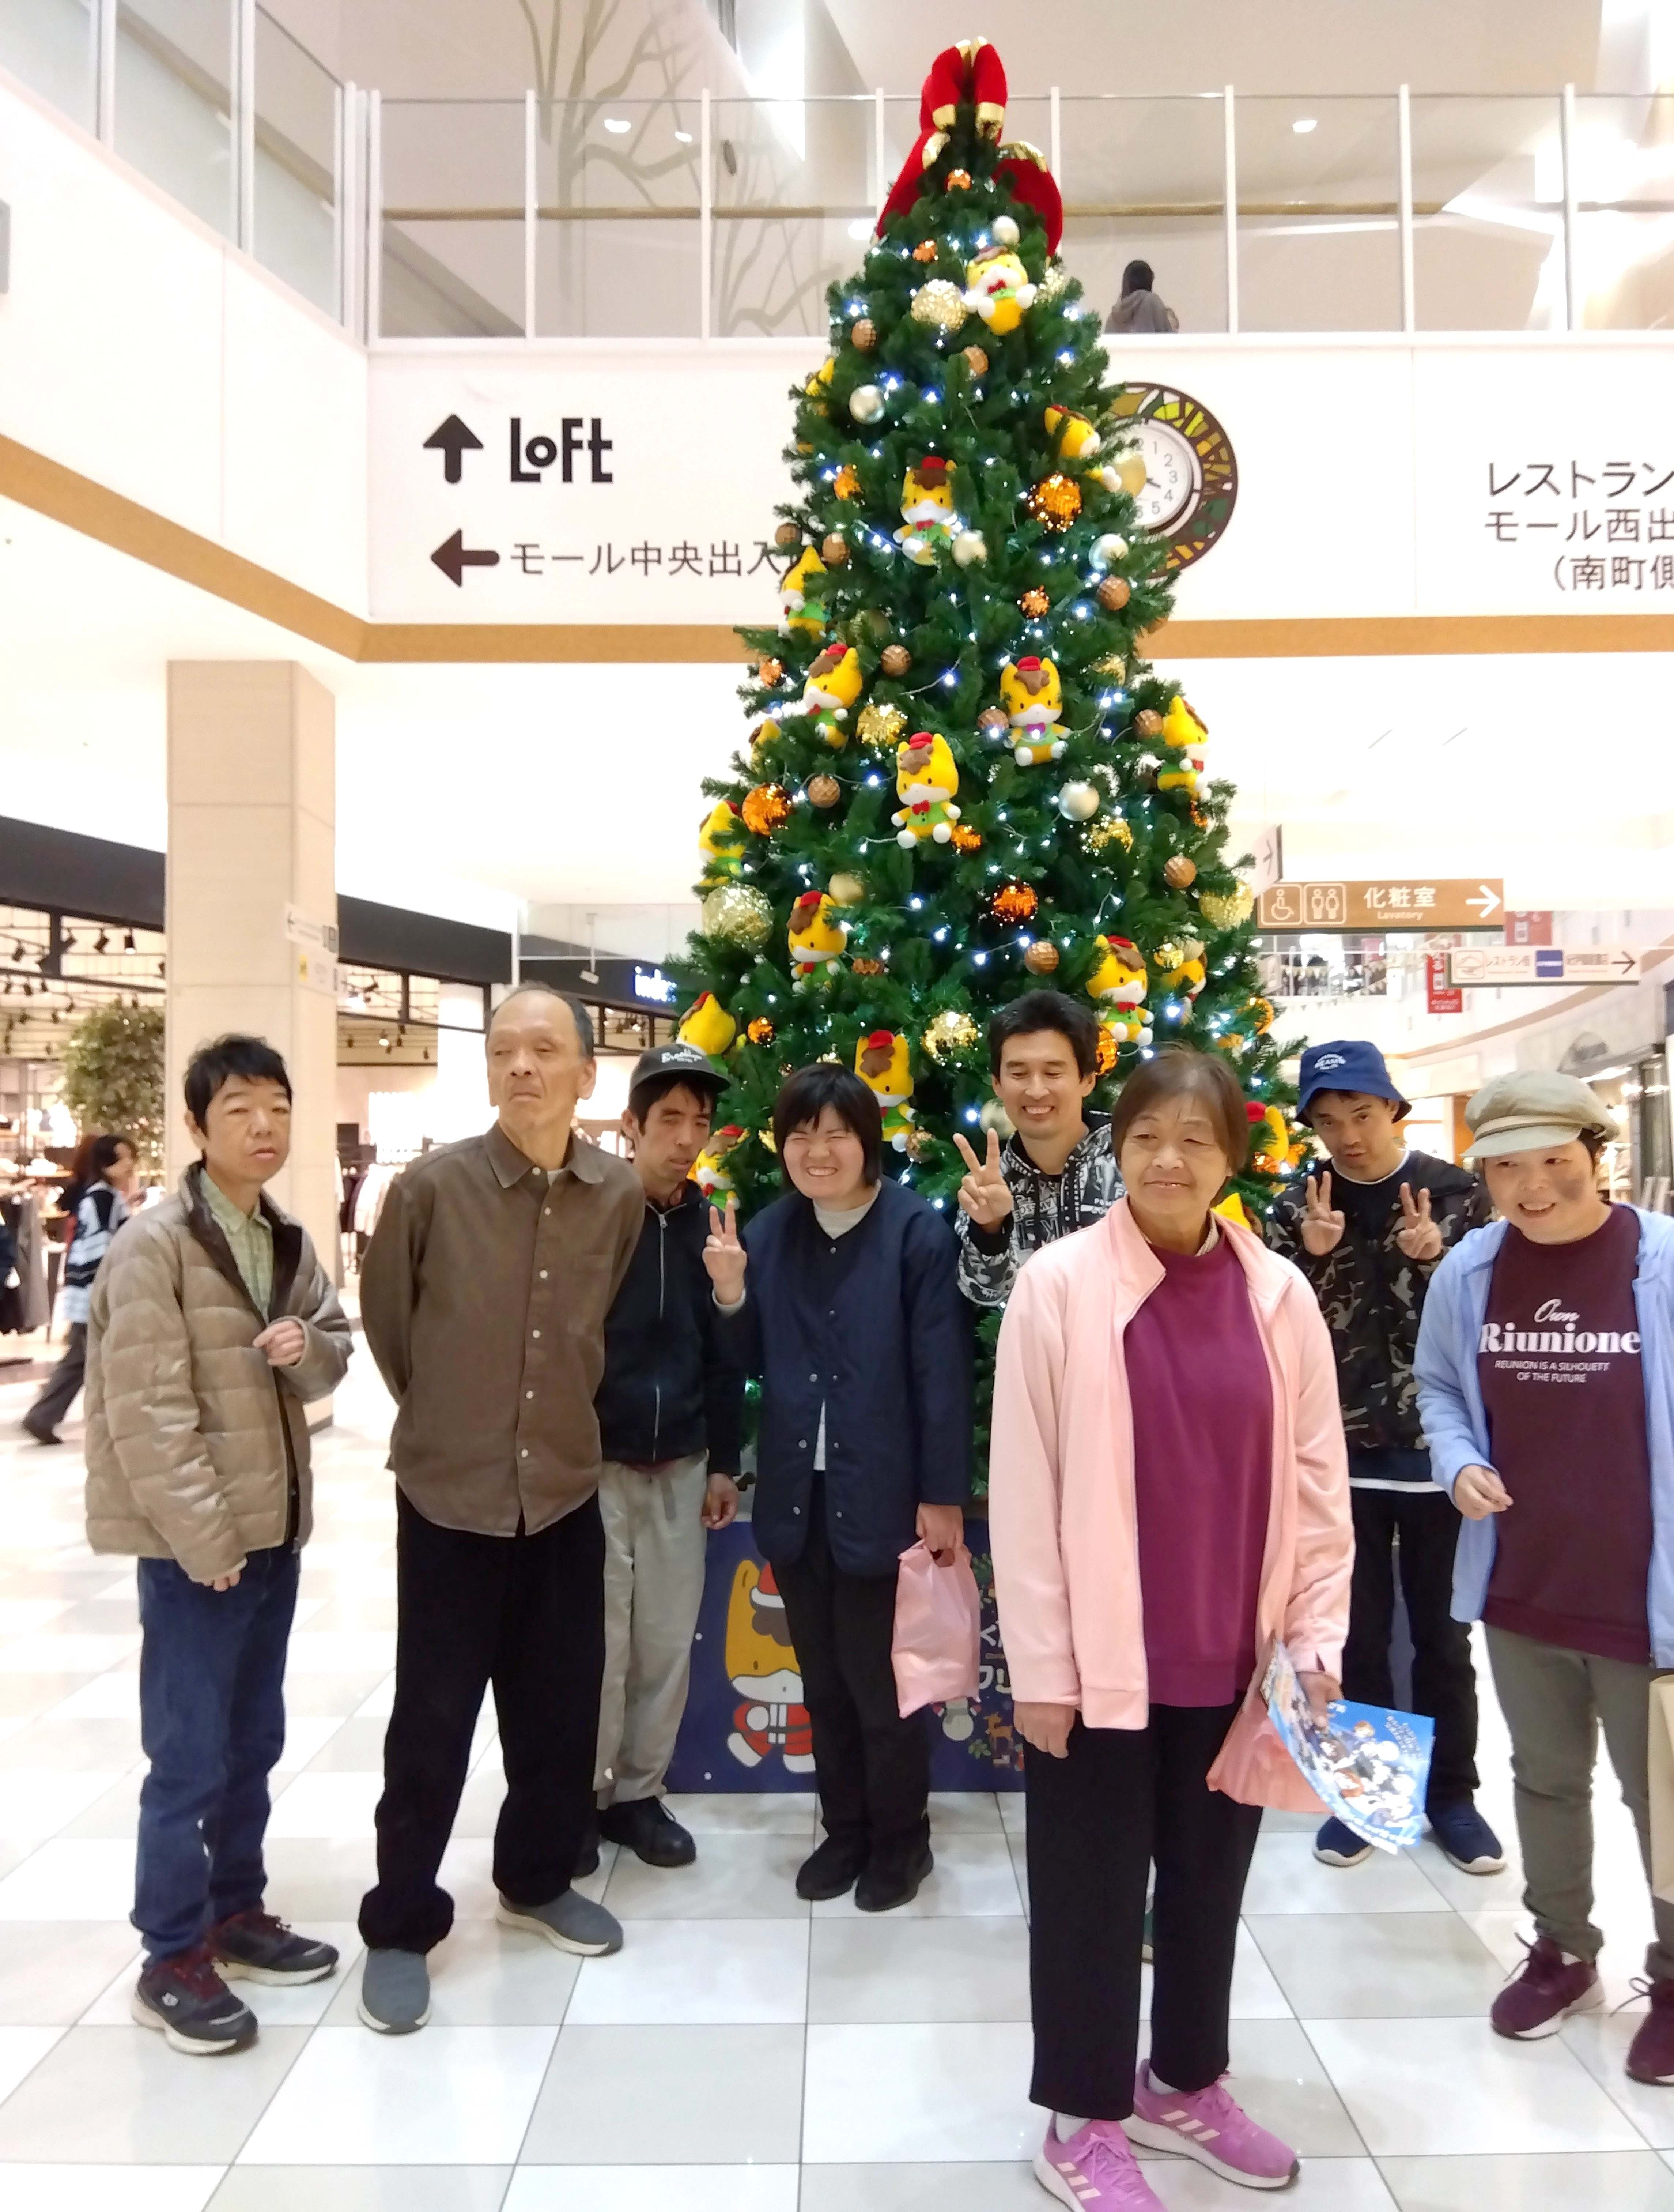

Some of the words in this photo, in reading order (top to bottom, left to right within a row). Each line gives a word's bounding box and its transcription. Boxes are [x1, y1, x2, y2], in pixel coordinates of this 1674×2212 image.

[1489, 460, 1674, 499] レストラン
[1363, 886, 1436, 909] 化粧室
[1377, 911, 1423, 920] Lavatory
[1478, 1322, 1641, 1353] Riunione
[1494, 1360, 1539, 1370] REUNION
[1539, 1361, 1549, 1370] IS
[1549, 1361, 1558, 1370] A
[1517, 1372, 1531, 1381] OF
[1532, 1372, 1550, 1381] THE
[1551, 1373, 1587, 1383] FUTURE
